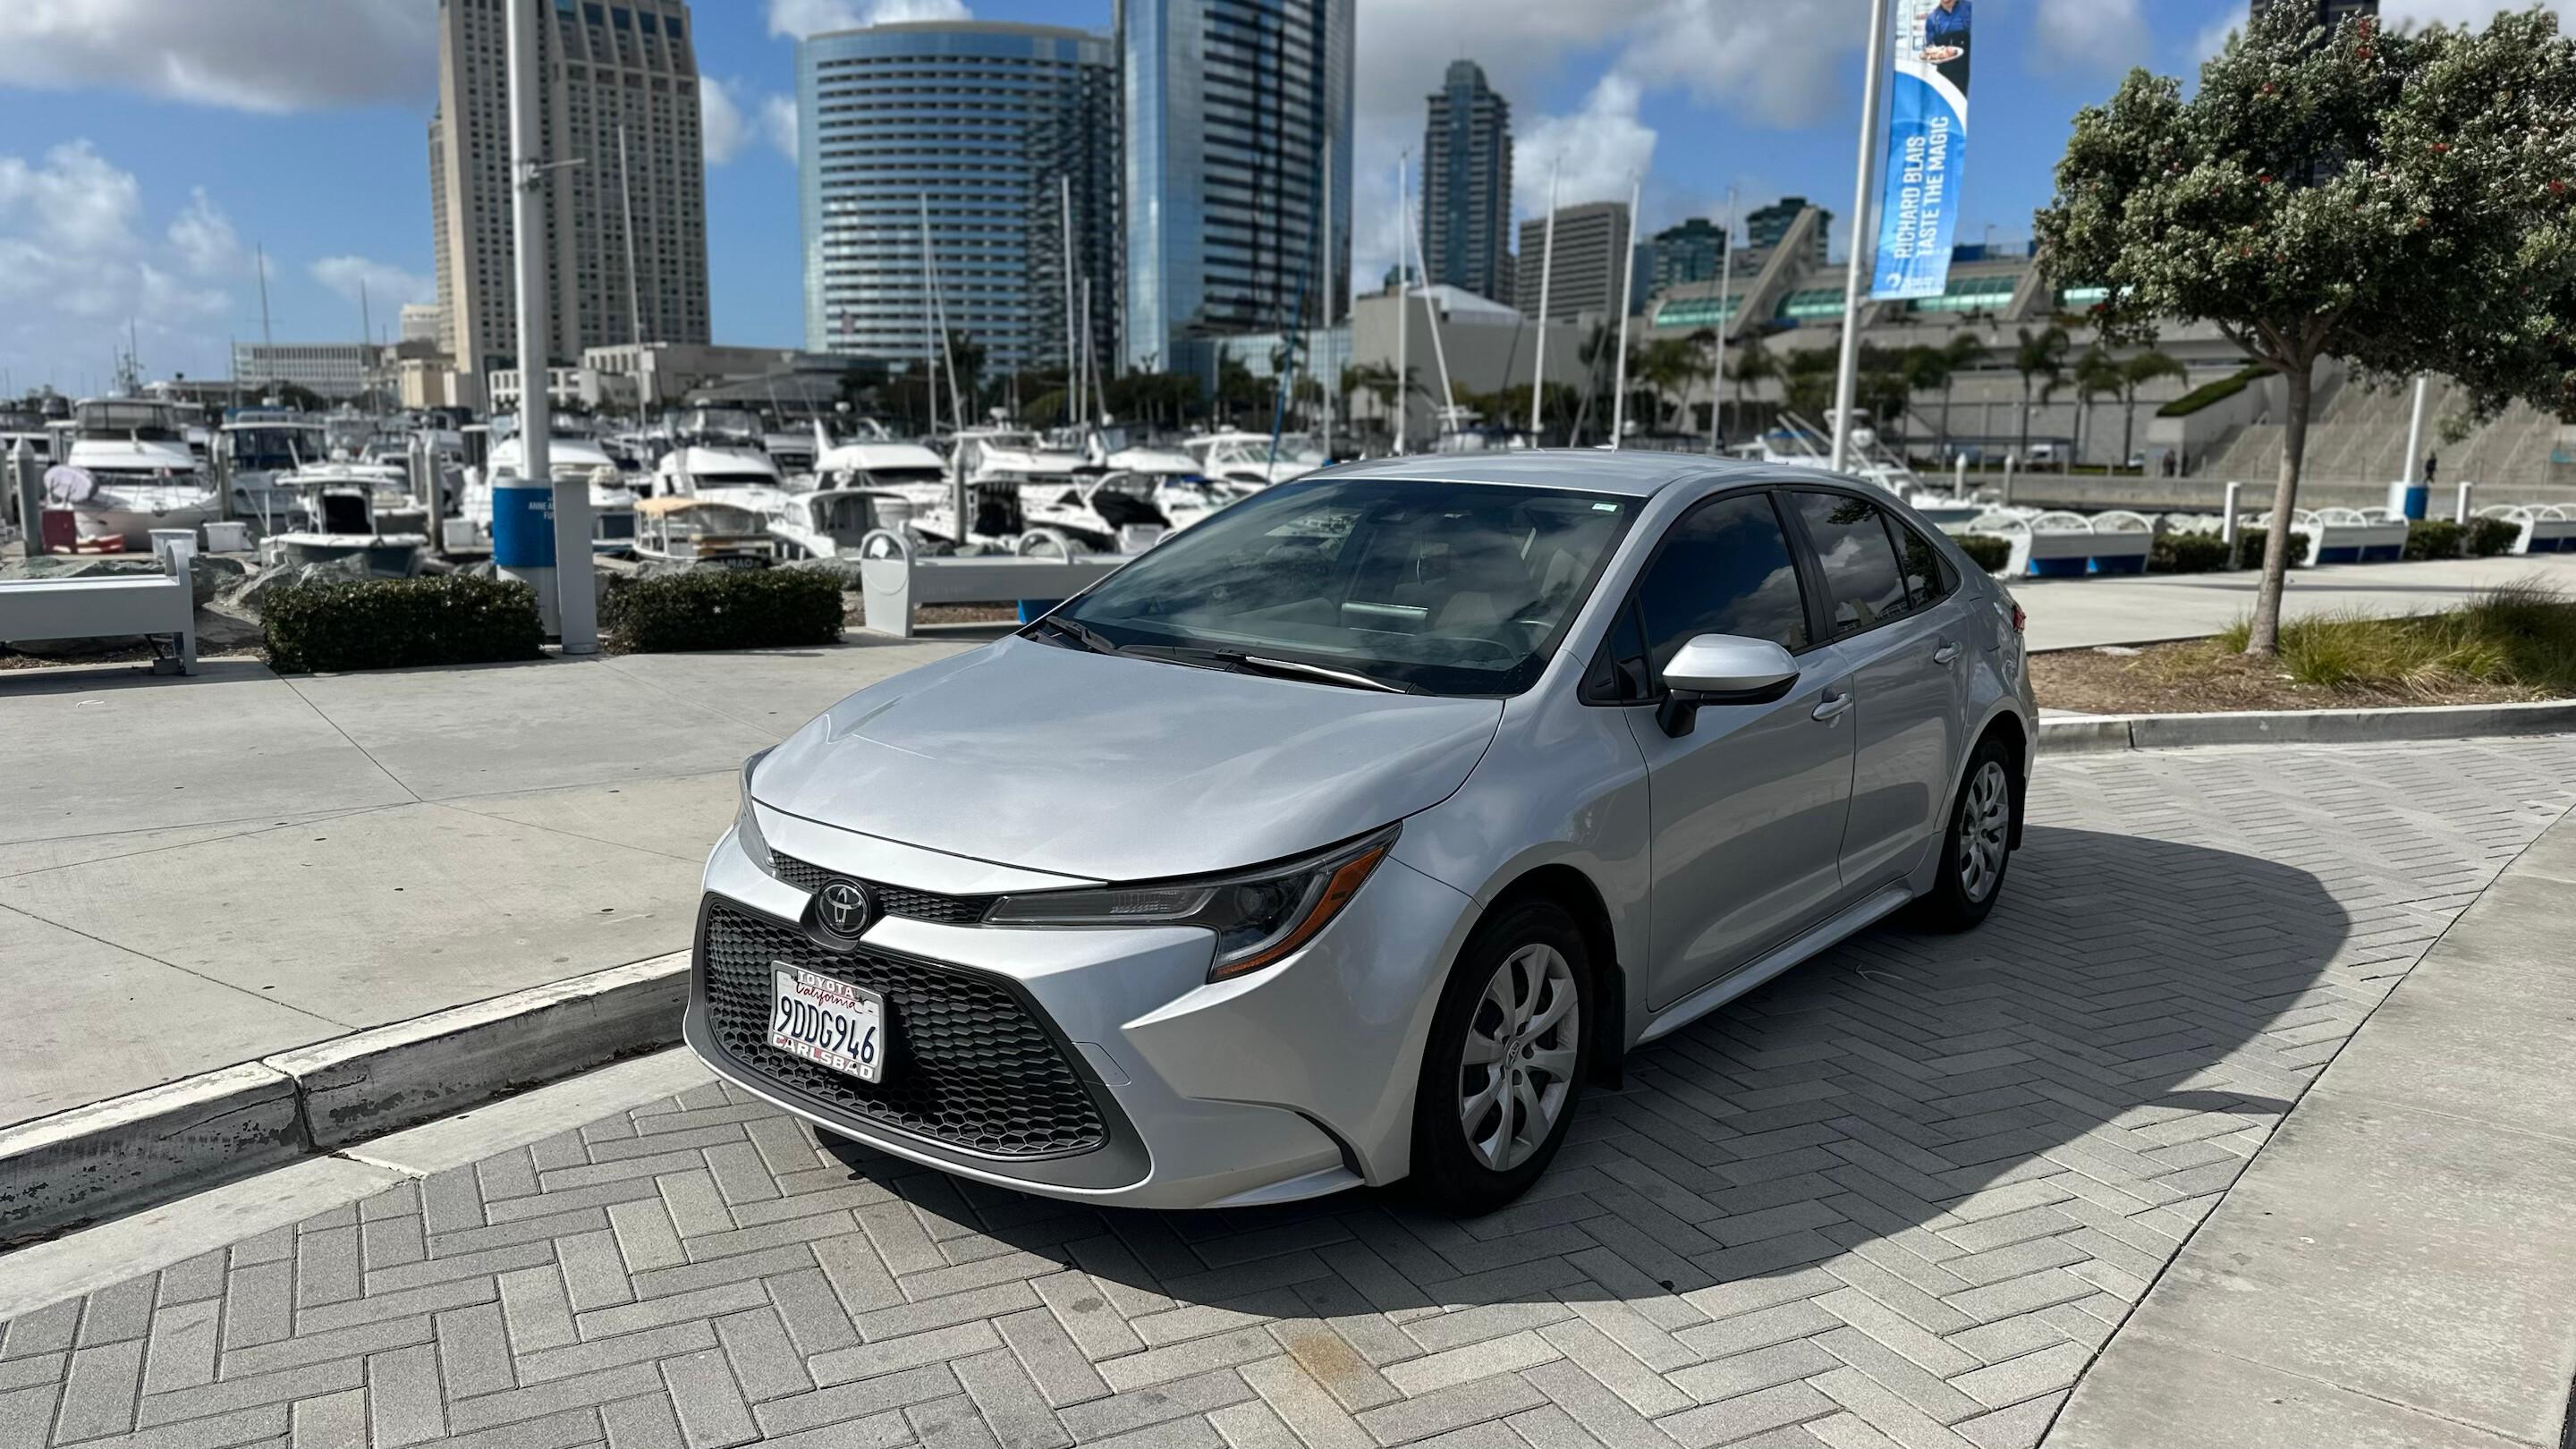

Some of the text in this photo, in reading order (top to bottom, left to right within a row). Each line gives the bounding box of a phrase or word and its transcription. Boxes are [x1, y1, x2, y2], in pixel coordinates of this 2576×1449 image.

[1903, 136, 1926, 183] BLAIS
[1928, 116, 1950, 172] MAGIC
[1924, 173, 1944, 206] THE
[1894, 186, 1920, 258] RICHARD
[1916, 207, 1940, 258] TASTE
[797, 970, 856, 1000] TOYOTA
[777, 996, 876, 1063] 9DDG946
[772, 1032, 875, 1079] CARLSBAD
